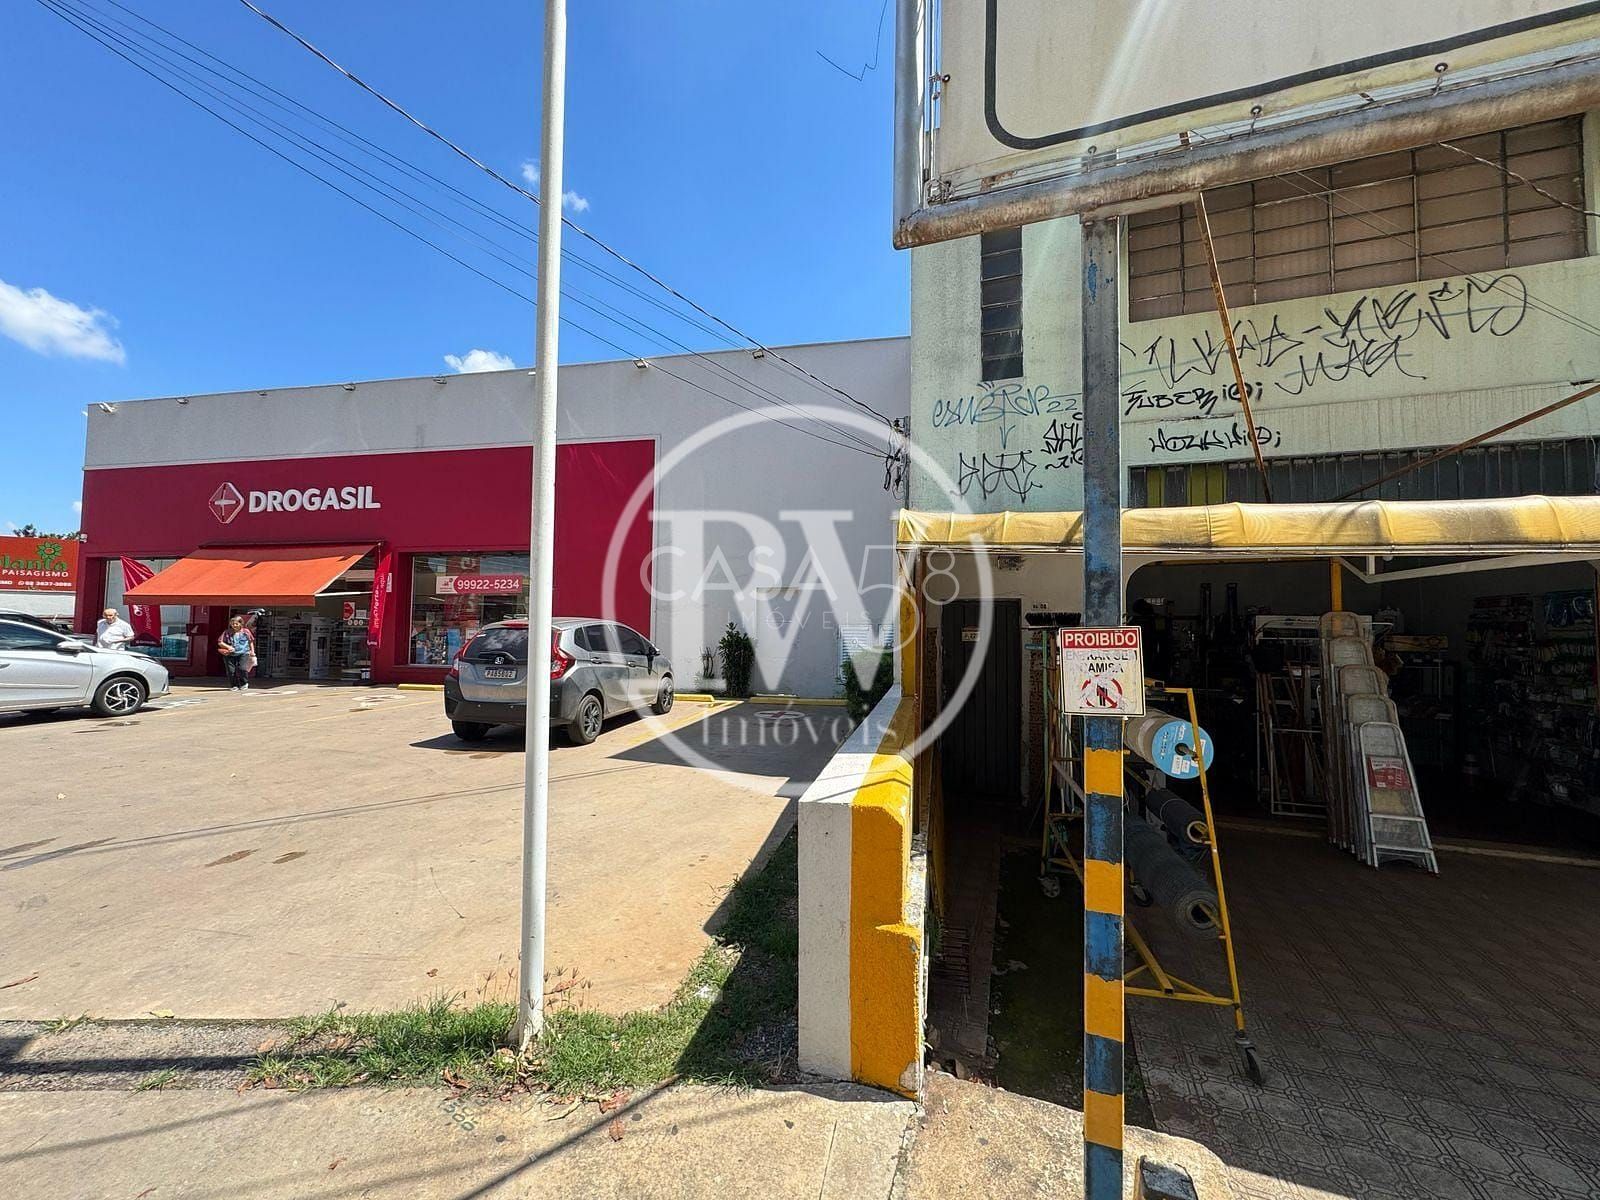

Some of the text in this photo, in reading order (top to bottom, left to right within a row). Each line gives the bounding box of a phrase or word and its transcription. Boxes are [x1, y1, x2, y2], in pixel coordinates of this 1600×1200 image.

[249, 486, 381, 513] DROGASIL
[2, 569, 69, 577] PAISAGISMO
[457, 580, 520, 590] 99922-5234
[1065, 632, 1137, 646] PROIBIDO
